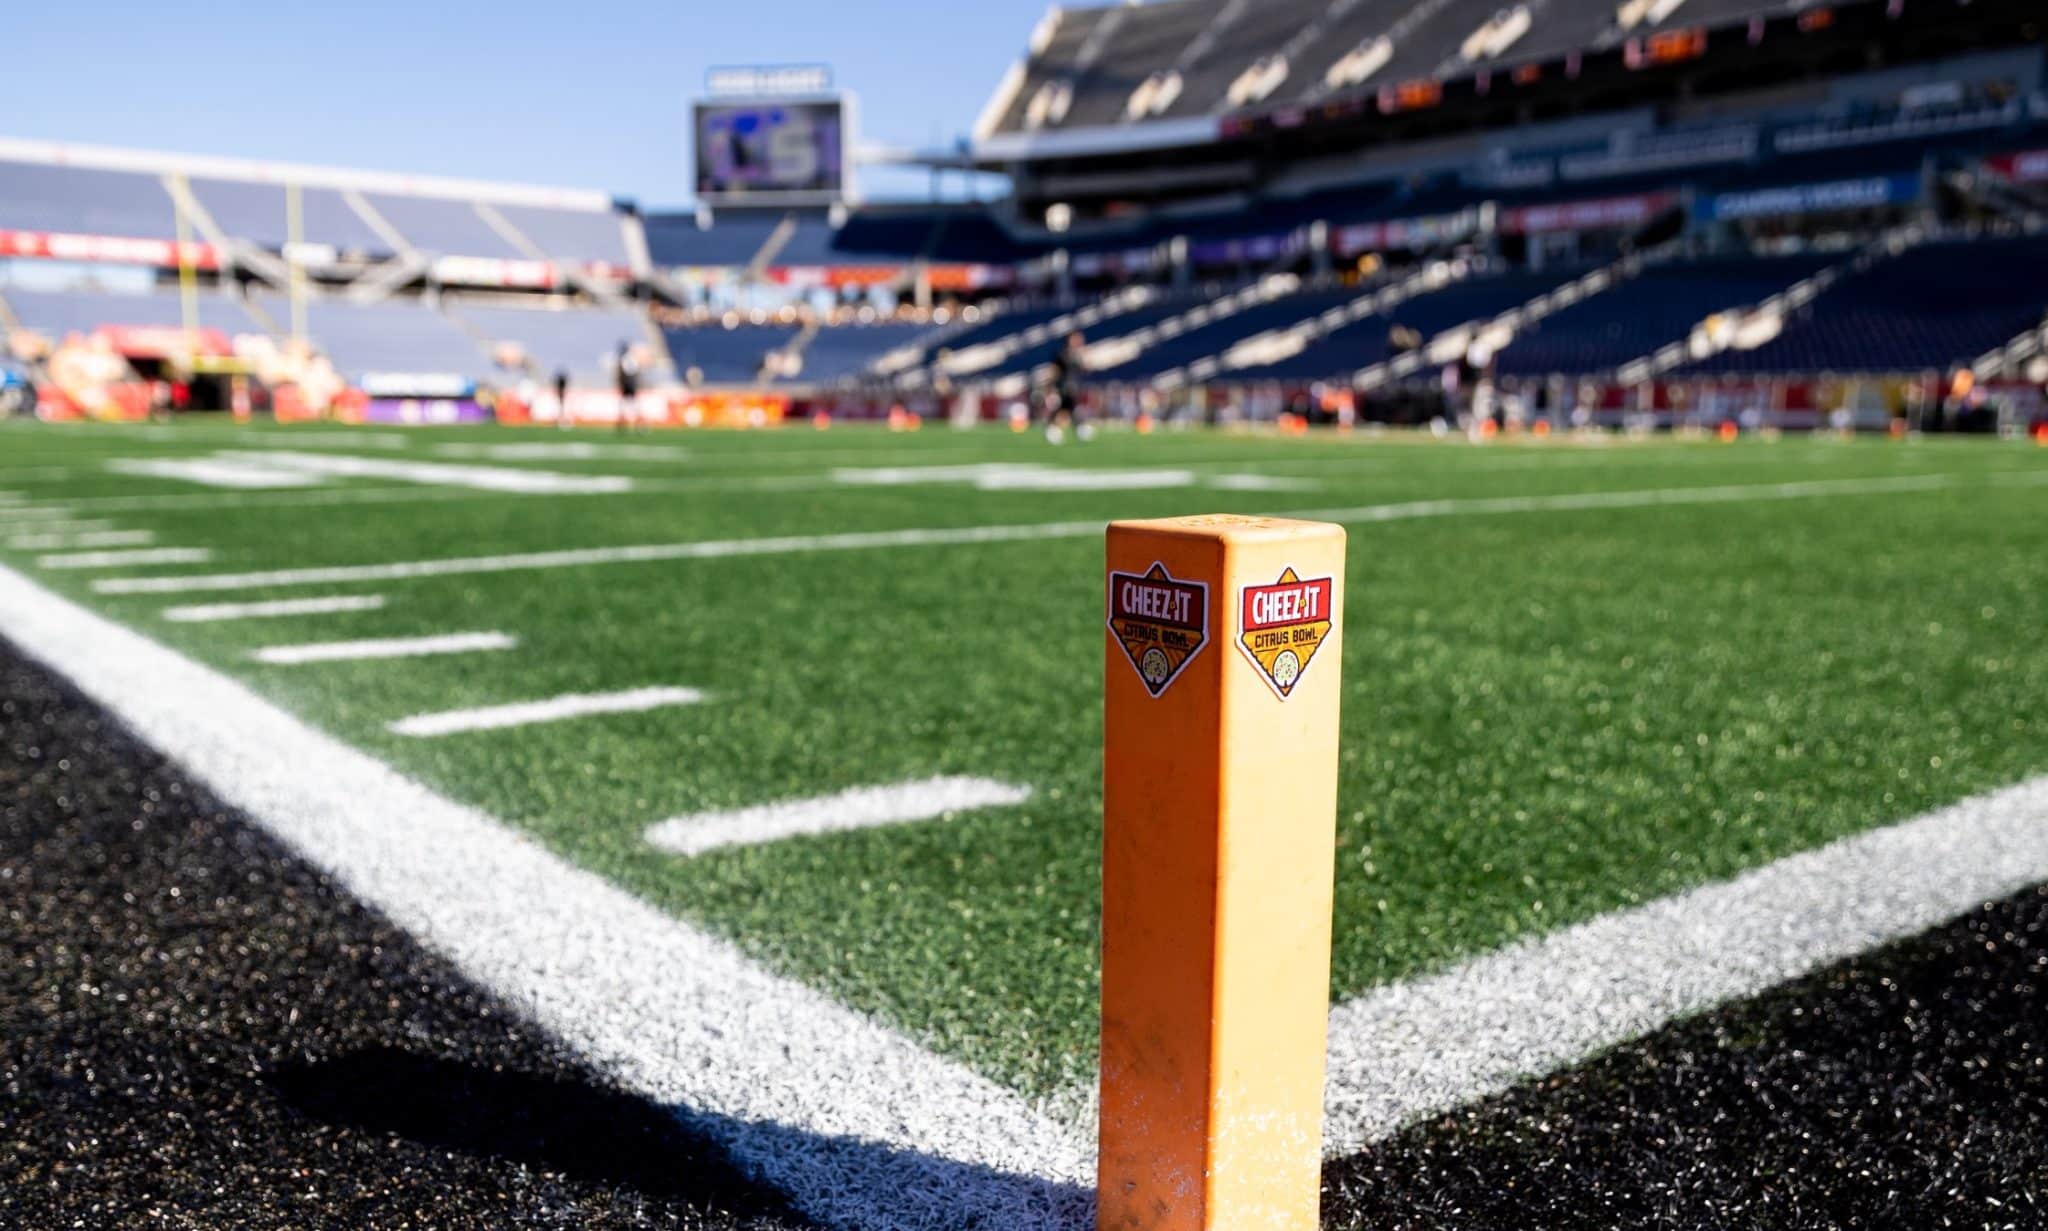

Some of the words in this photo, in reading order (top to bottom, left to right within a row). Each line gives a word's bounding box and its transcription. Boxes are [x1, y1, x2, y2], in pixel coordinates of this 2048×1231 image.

[1124, 623, 1158, 641] CITRUS
[1162, 630, 1189, 647] BOWL
[1255, 631, 1289, 648] CITRUS
[1293, 627, 1318, 643] BOWL
